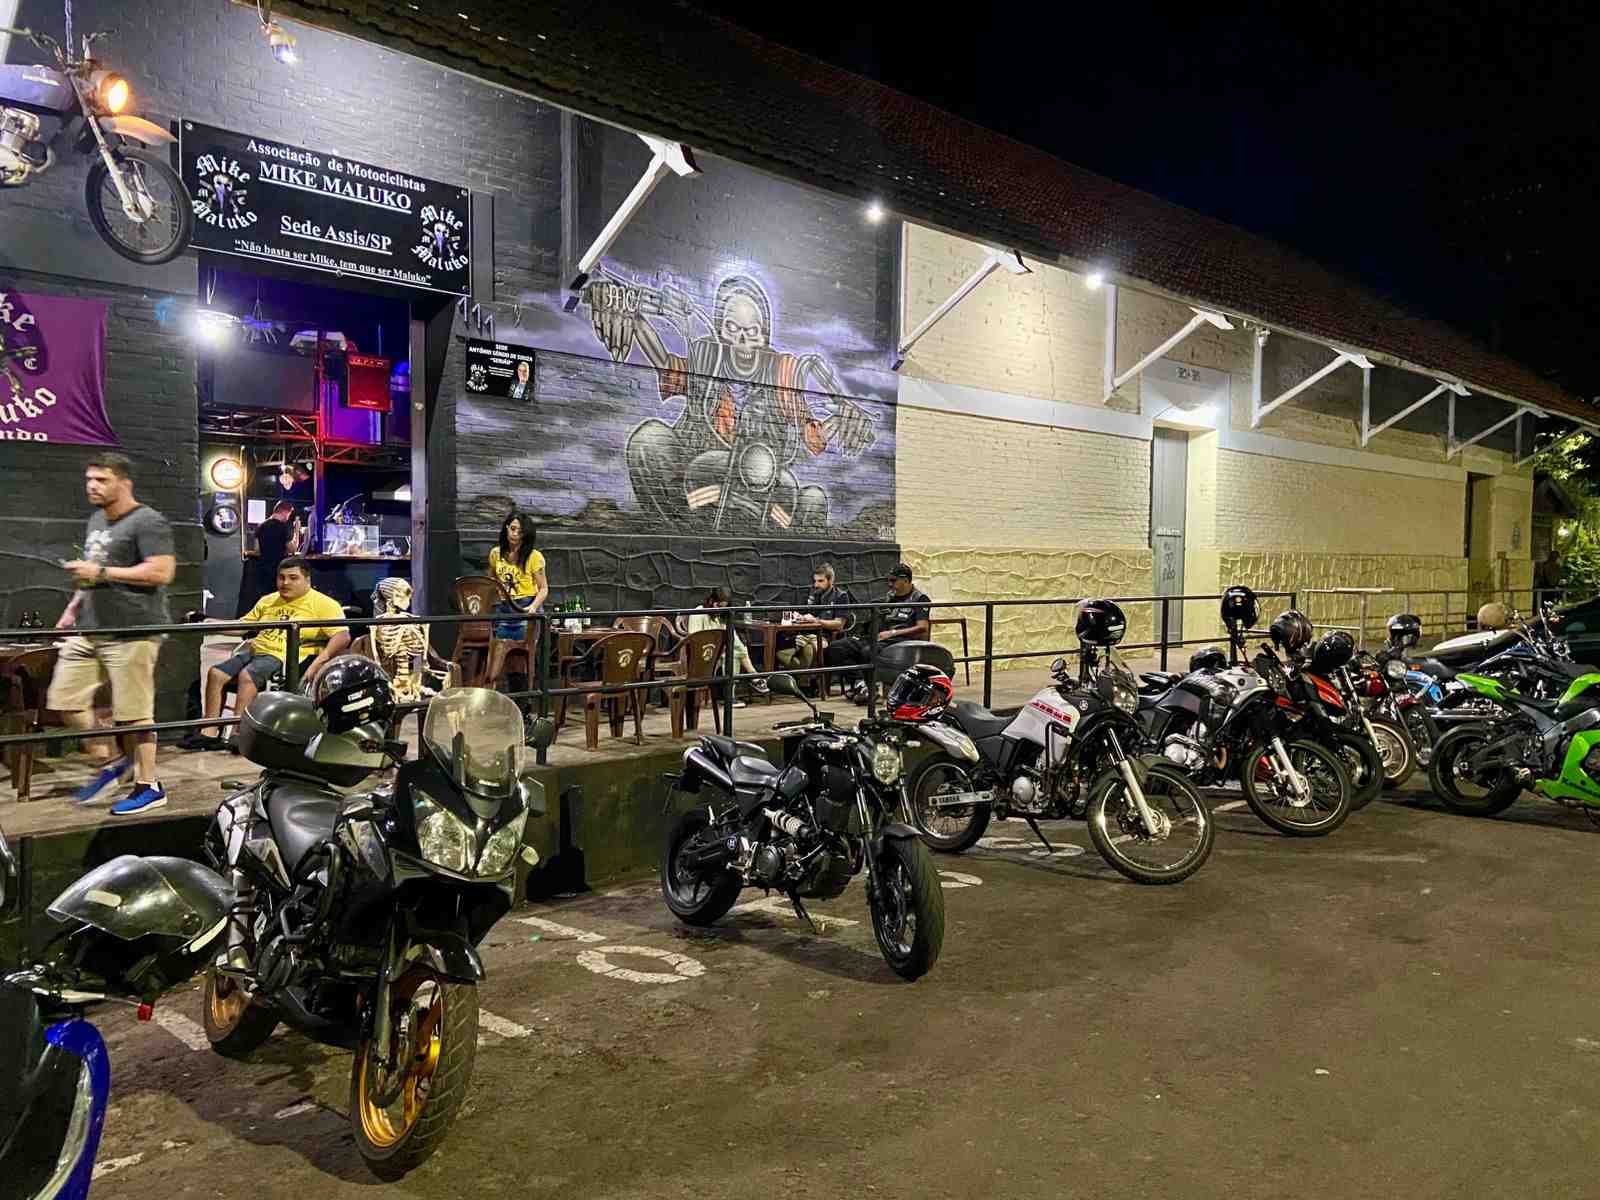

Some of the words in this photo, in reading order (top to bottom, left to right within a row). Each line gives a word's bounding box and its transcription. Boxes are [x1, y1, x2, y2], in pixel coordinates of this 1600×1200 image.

[196, 154, 250, 183] Mike
[246, 139, 320, 167] Associação
[327, 158, 343, 172] de
[346, 162, 426, 193] Motociclistas
[259, 160, 318, 188] MIKE
[321, 175, 412, 210] MALUKO
[191, 199, 258, 230] Maluko
[420, 205, 463, 230] Mike
[280, 215, 321, 237] Sede
[324, 224, 392, 250] Assis/SP
[264, 244, 291, 257] basta
[292, 250, 308, 260] ser
[310, 253, 338, 267] Mike,
[340, 259, 357, 270] tem
[359, 264, 375, 275] que
[377, 268, 392, 276] ser
[410, 245, 468, 271] Maluko
